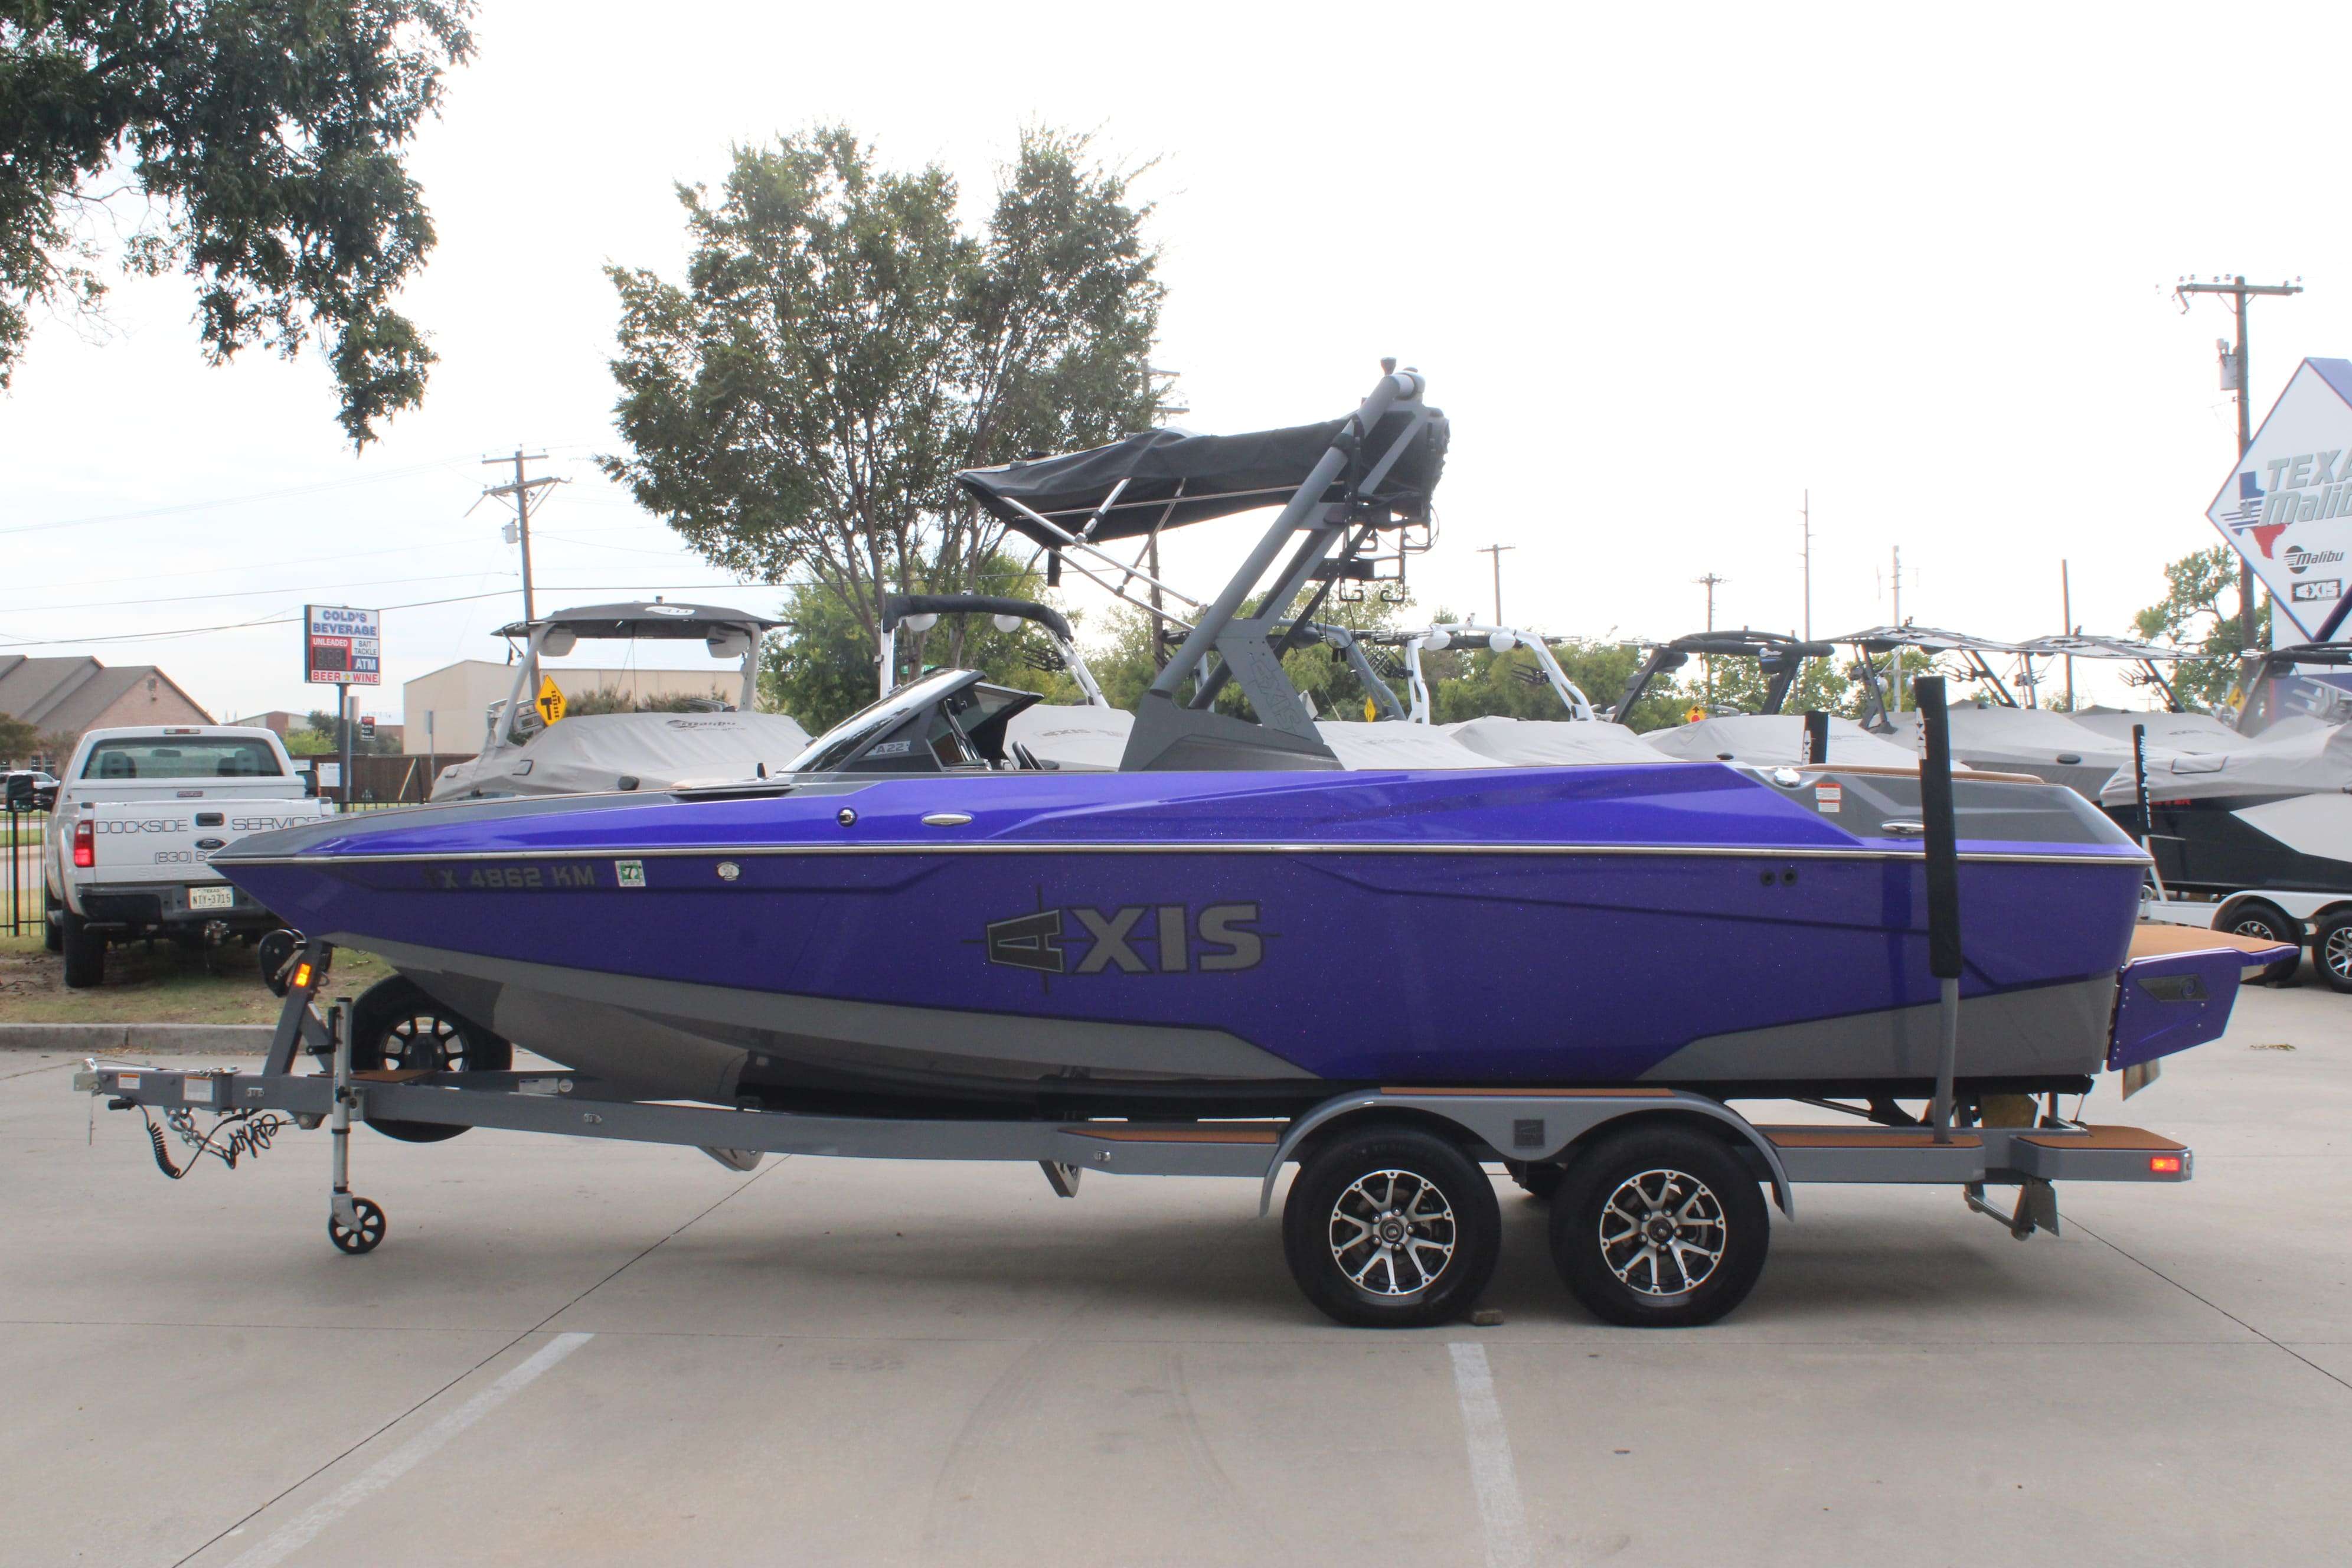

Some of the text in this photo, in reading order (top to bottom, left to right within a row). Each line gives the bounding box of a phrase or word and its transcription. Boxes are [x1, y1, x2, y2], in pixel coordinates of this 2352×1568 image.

[322, 610, 367, 622] COLD'S
[312, 622, 377, 636] BEVERAGE
[313, 638, 348, 647] UNLEADED
[355, 658, 377, 670] ATM
[313, 671, 378, 683] BEER WINE
[96, 819, 189, 834] DOCKSIDE
[470, 867, 543, 888] 4862
[551, 864, 596, 887] KM
[986, 901, 1263, 974] AXIS
